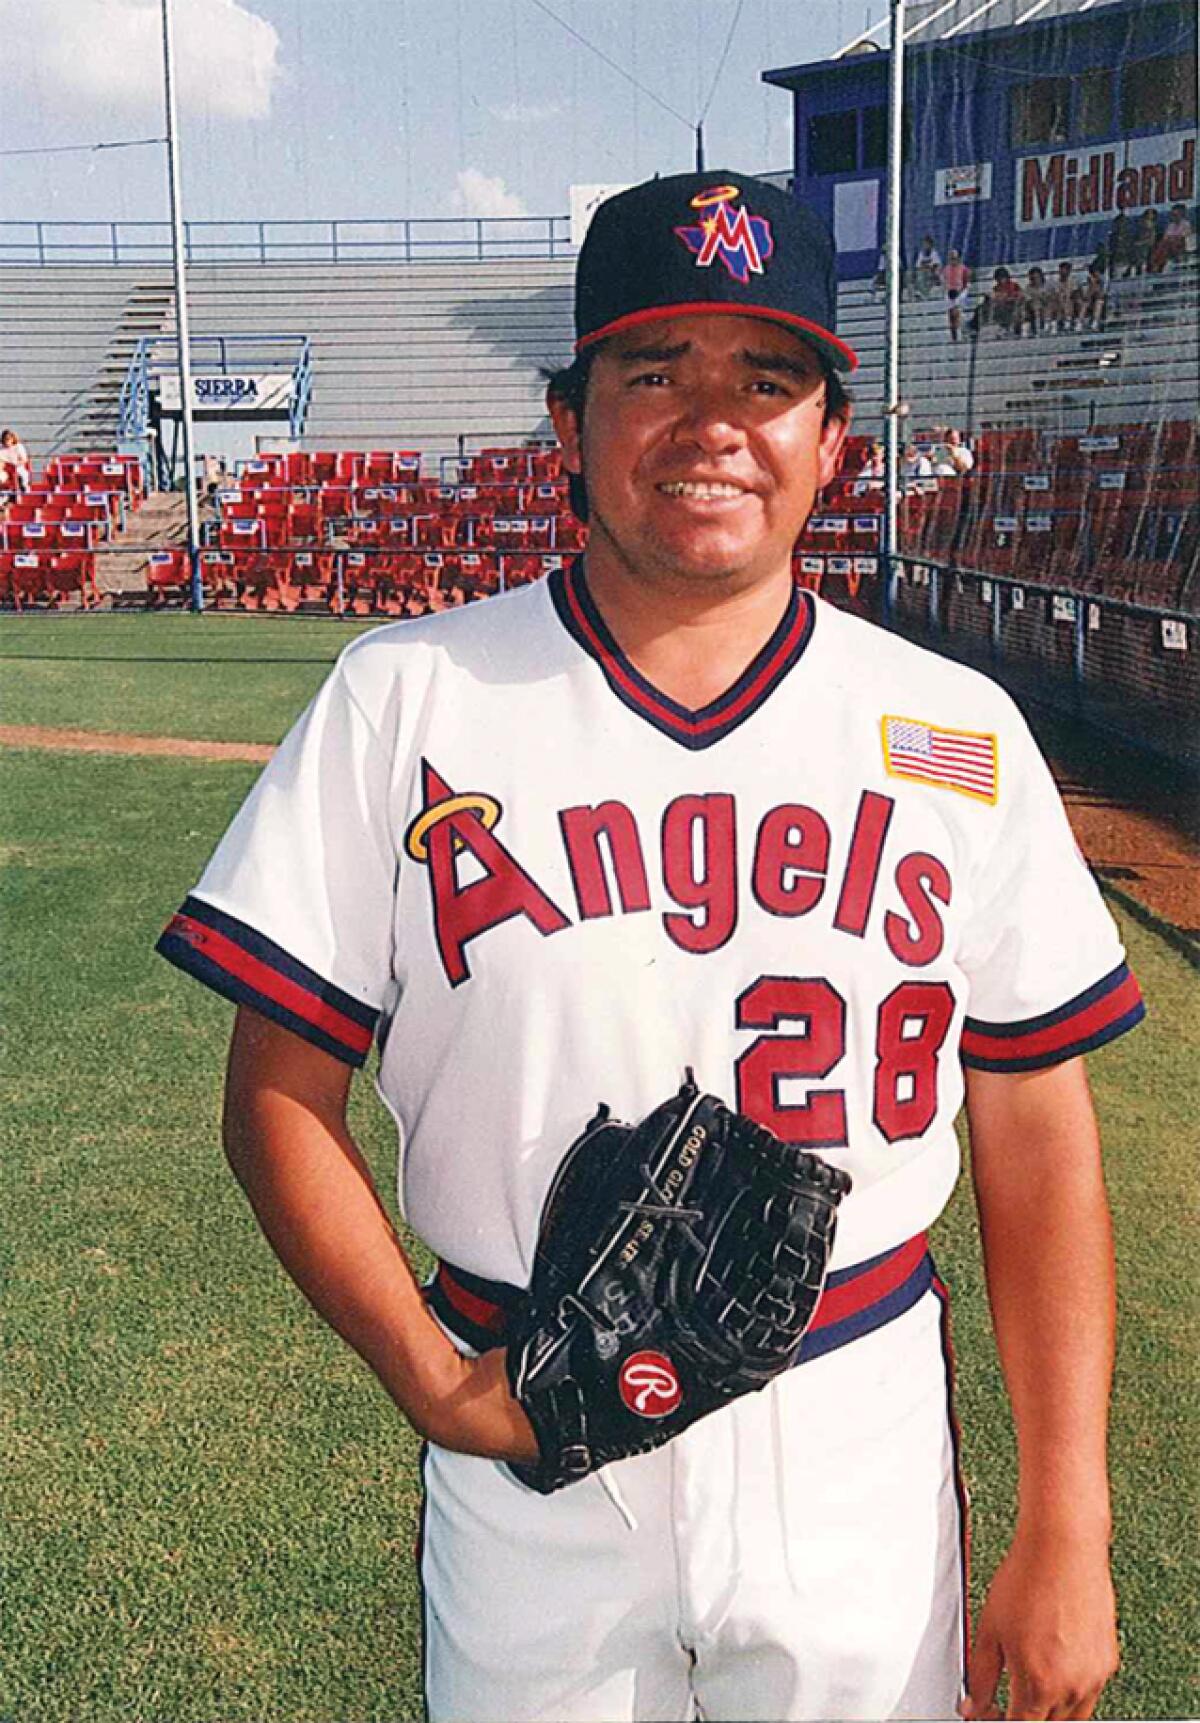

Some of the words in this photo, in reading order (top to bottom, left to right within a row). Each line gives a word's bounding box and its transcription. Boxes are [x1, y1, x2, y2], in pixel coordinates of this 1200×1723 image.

[1022, 138, 1196, 222] Midland
[696, 201, 764, 275] M
[194, 378, 258, 396] SIERRA
[404, 756, 953, 989] Angels
[734, 974, 957, 1149] 28
[679, 1123, 706, 1168] GOLD
[623, 1362, 678, 1411] R
